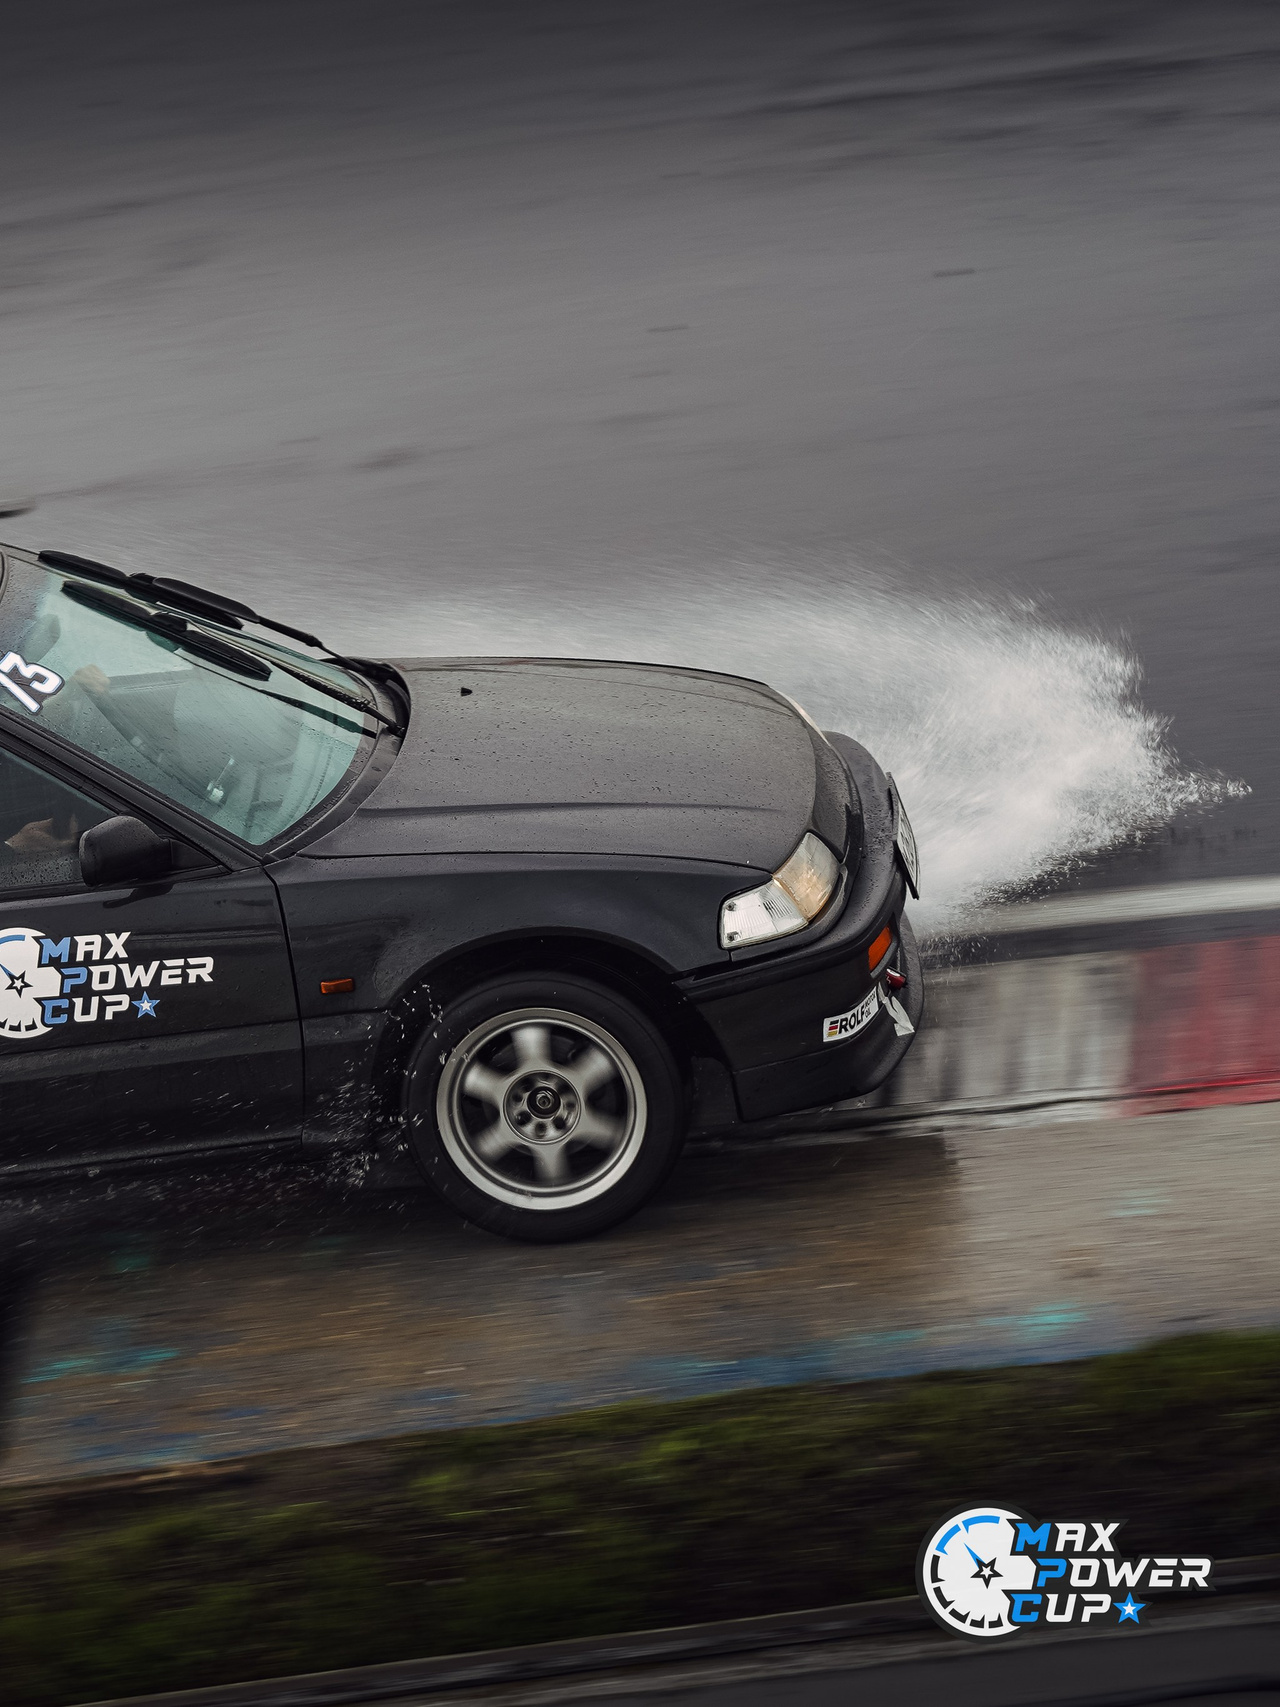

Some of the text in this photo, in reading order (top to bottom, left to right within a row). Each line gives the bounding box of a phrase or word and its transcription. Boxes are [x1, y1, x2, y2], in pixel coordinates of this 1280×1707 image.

[39, 931, 131, 965] MAX
[60, 956, 214, 994] POWER
[41, 993, 131, 1025] CUP
[838, 1003, 865, 1034] ROLF
